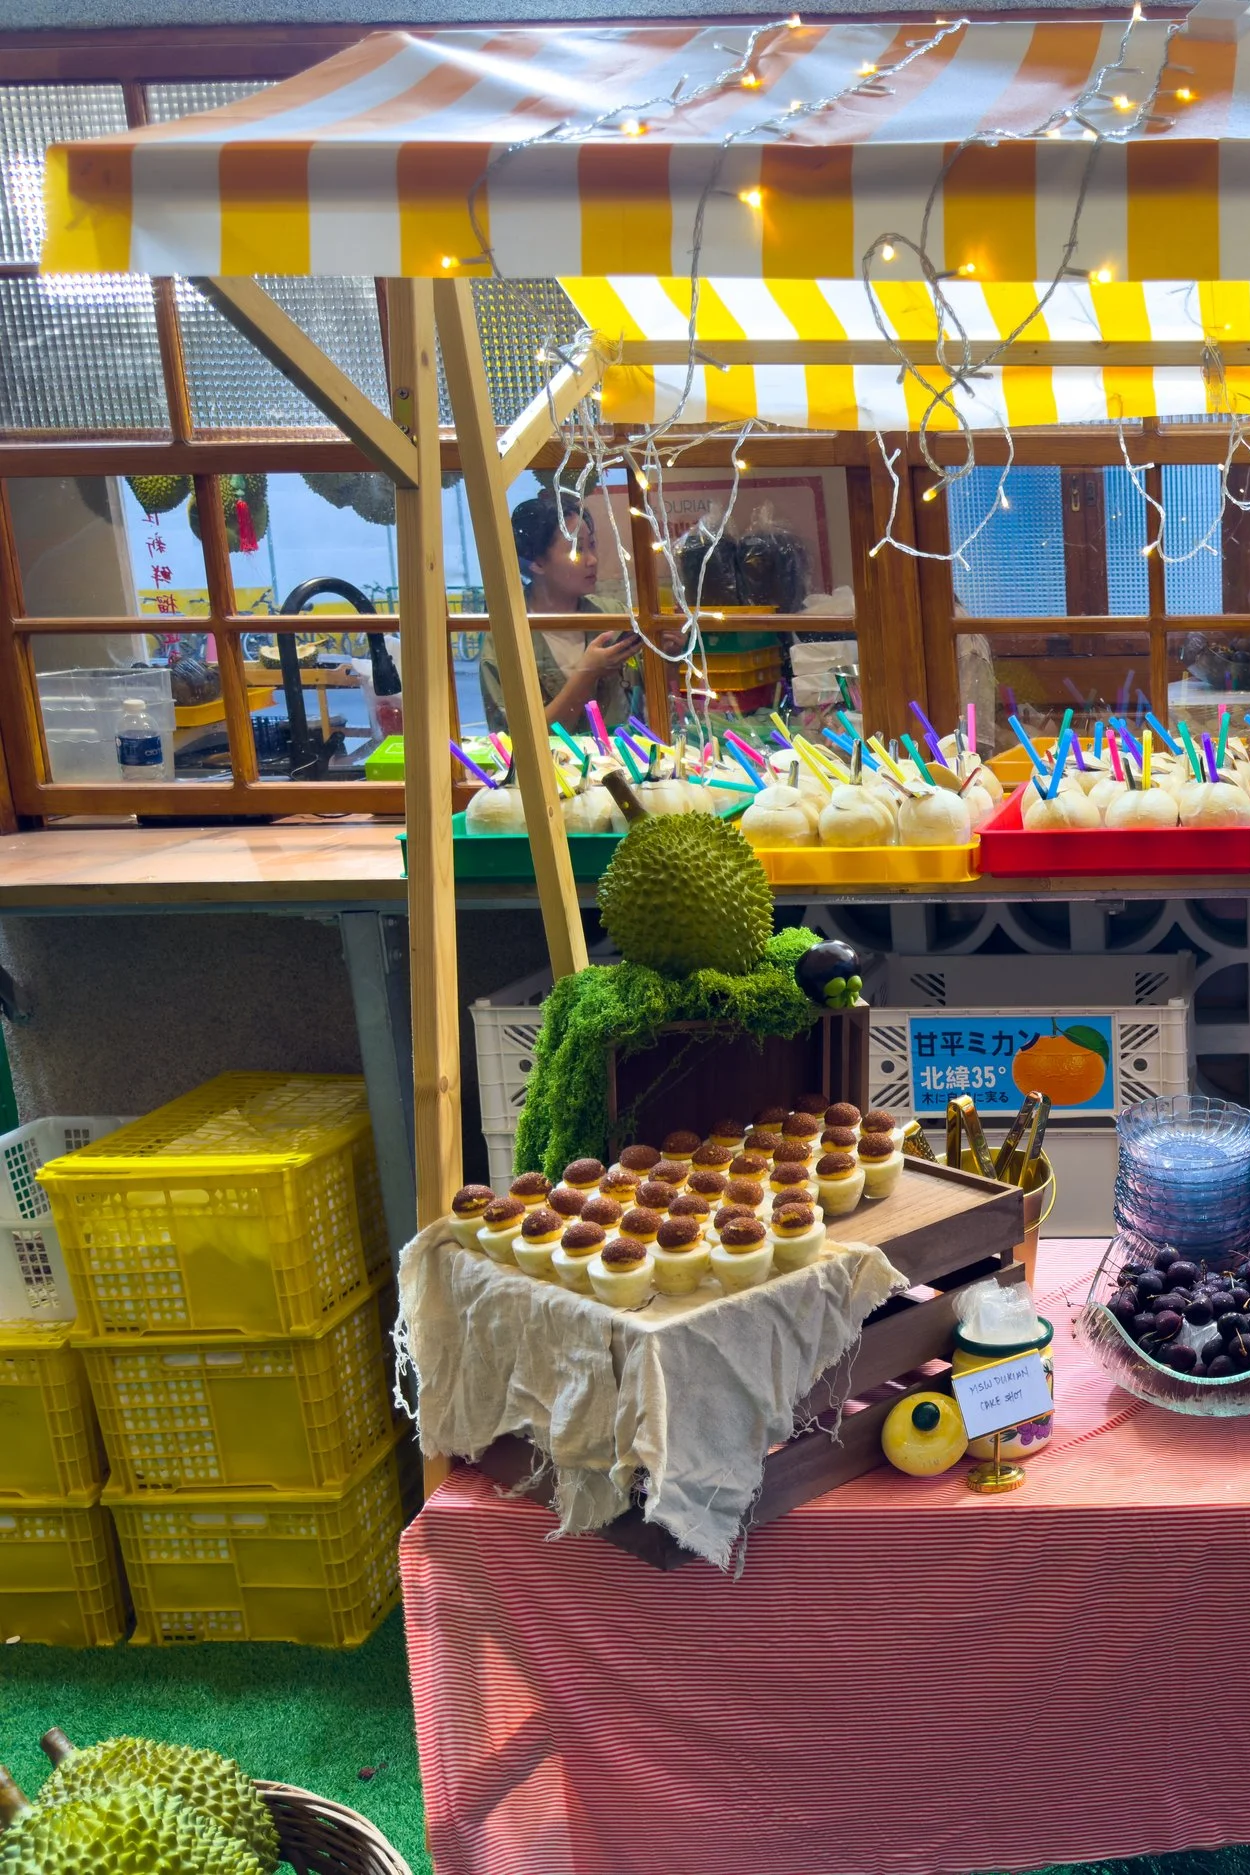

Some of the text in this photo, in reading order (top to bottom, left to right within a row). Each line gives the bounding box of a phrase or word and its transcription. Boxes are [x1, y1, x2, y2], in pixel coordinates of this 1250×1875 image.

[914, 1030, 1040, 1056] 甘平ミカン
[920, 1065, 1007, 1091] 北緯35°
[922, 1092, 1009, 1104] 木に自に実る
[969, 1366, 1029, 1395] MSW DURIAN
[980, 1388, 1023, 1411] CAKE SHOT
